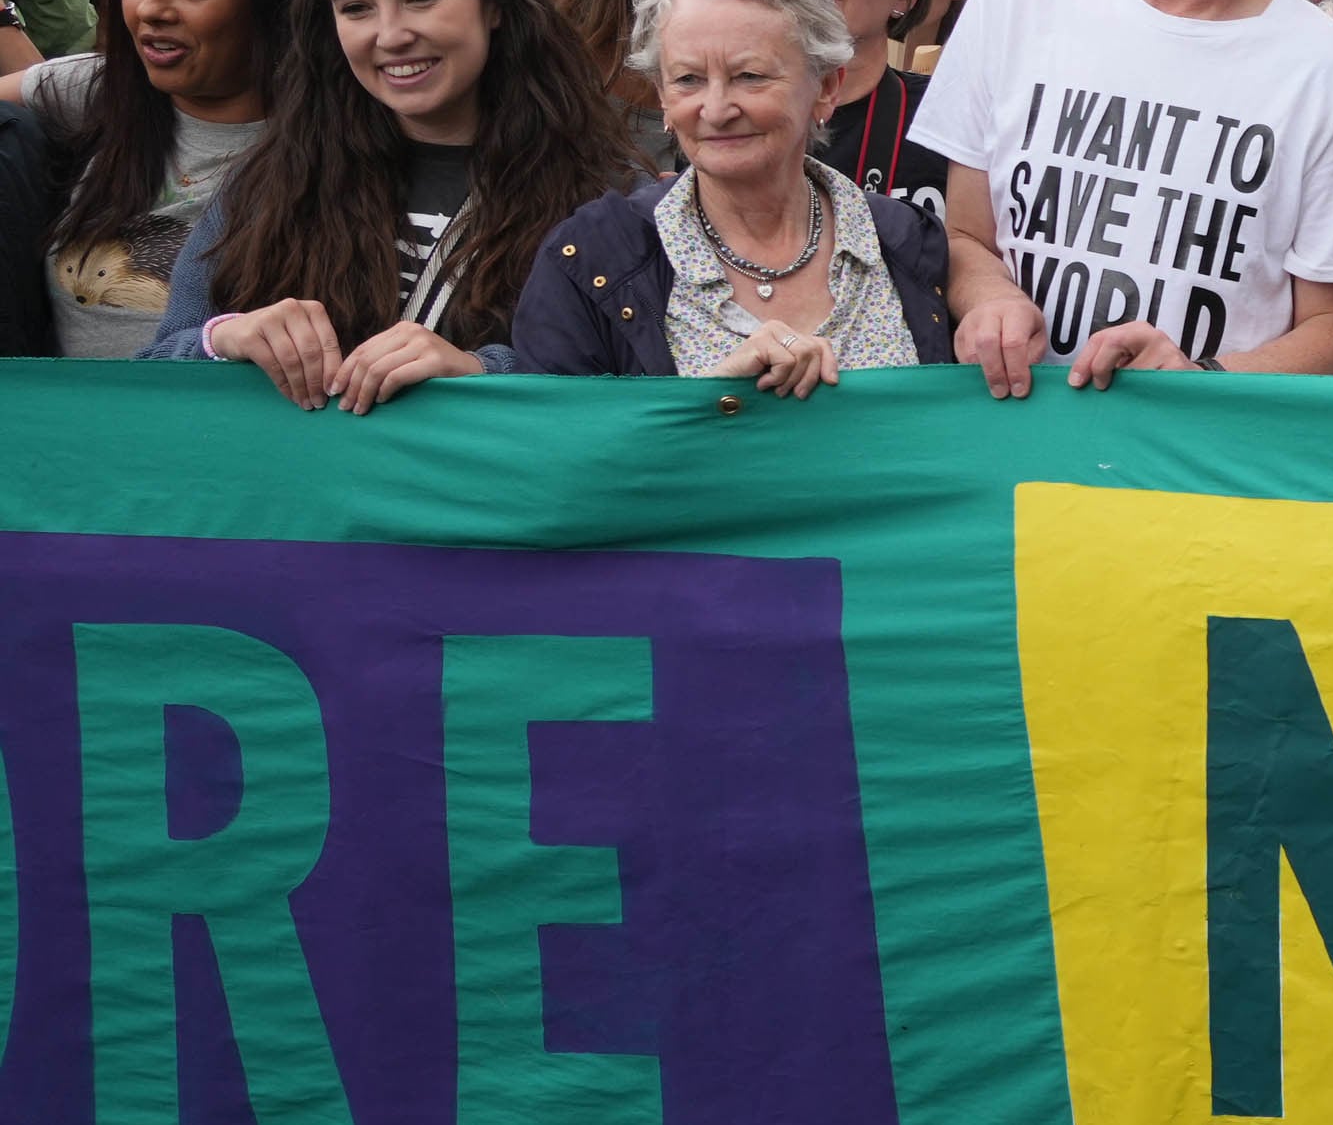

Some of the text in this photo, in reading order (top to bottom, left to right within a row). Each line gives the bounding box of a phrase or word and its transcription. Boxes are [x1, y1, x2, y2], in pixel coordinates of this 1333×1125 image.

[1021, 83, 1275, 194] I WANT TO
[1008, 160, 1258, 283] SAVE THE
